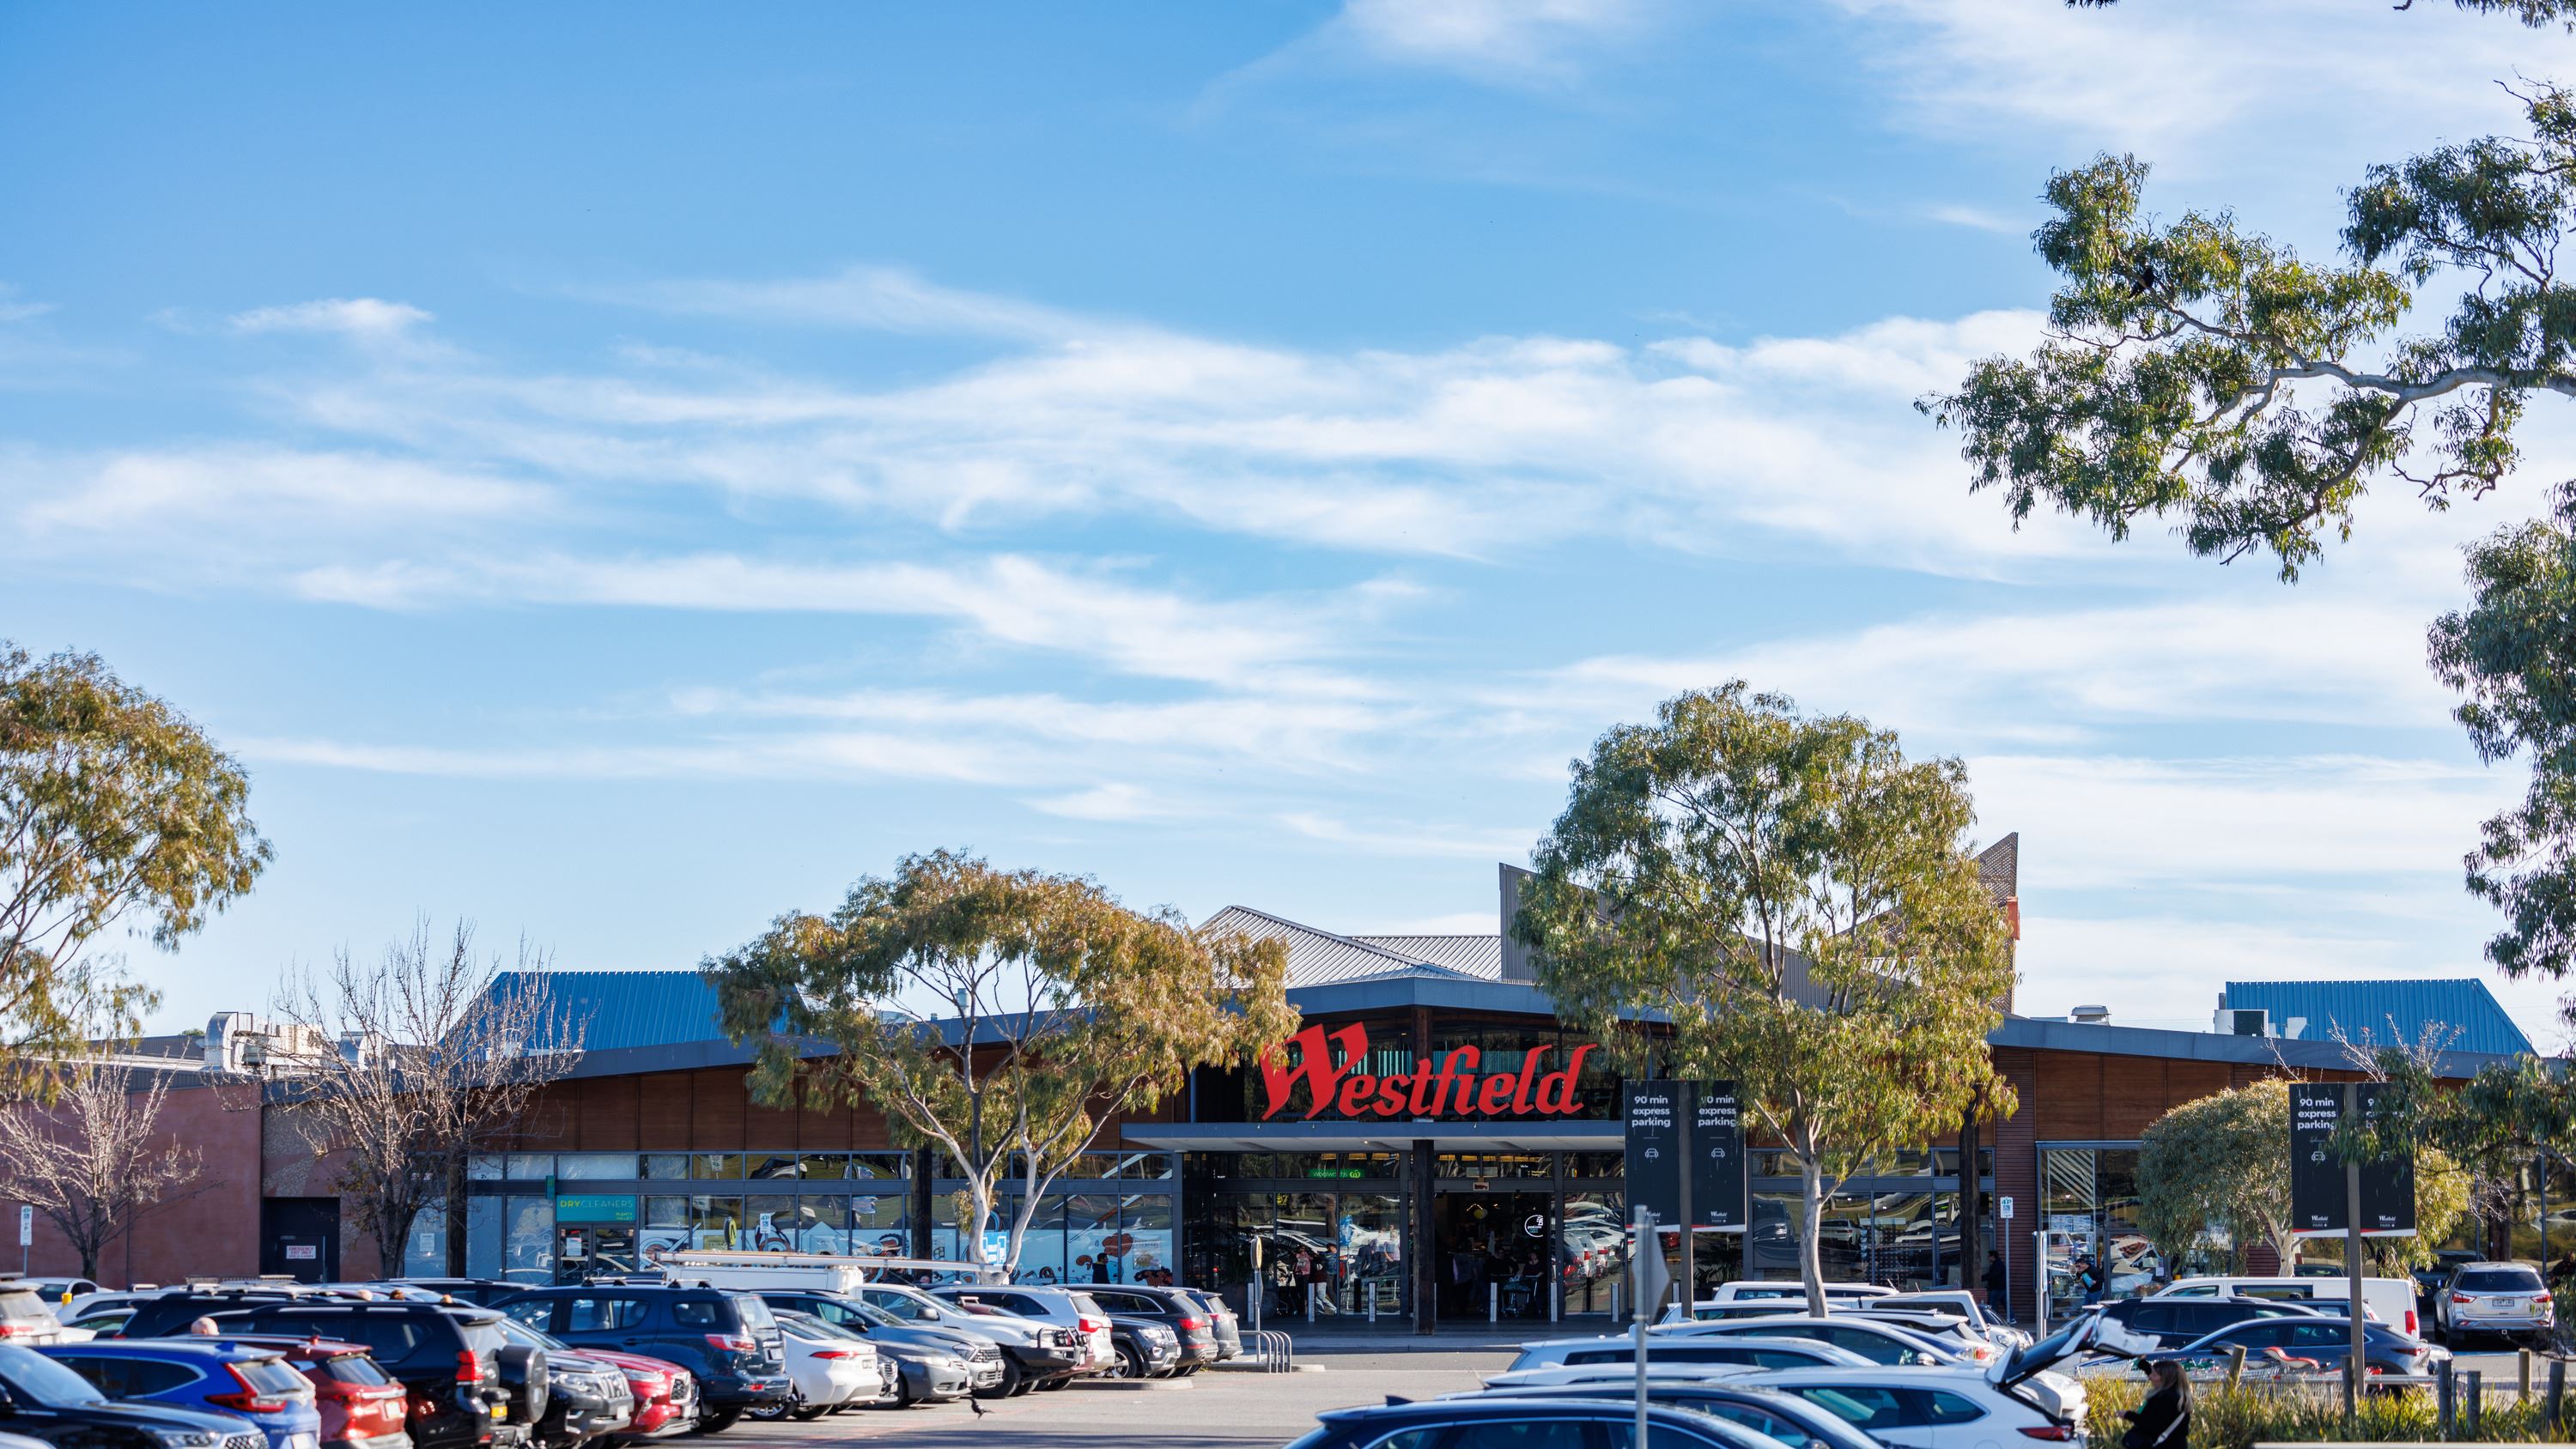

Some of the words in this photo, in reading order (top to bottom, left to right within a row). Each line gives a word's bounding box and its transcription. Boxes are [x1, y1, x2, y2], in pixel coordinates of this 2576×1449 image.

[1260, 1021, 1598, 1120] Westfield
[1634, 1095, 1647, 1105] 90
[1649, 1095, 1668, 1104] min
[1716, 1094, 1735, 1104] min
[2300, 1098, 2312, 1106] 90
[2315, 1097, 2334, 1106] min
[1632, 1106, 1670, 1117] express
[1698, 1107, 1736, 1117] express
[2298, 1110, 2336, 1119] express
[1631, 1117, 1671, 1127] parking
[1698, 1117, 1736, 1127] parking
